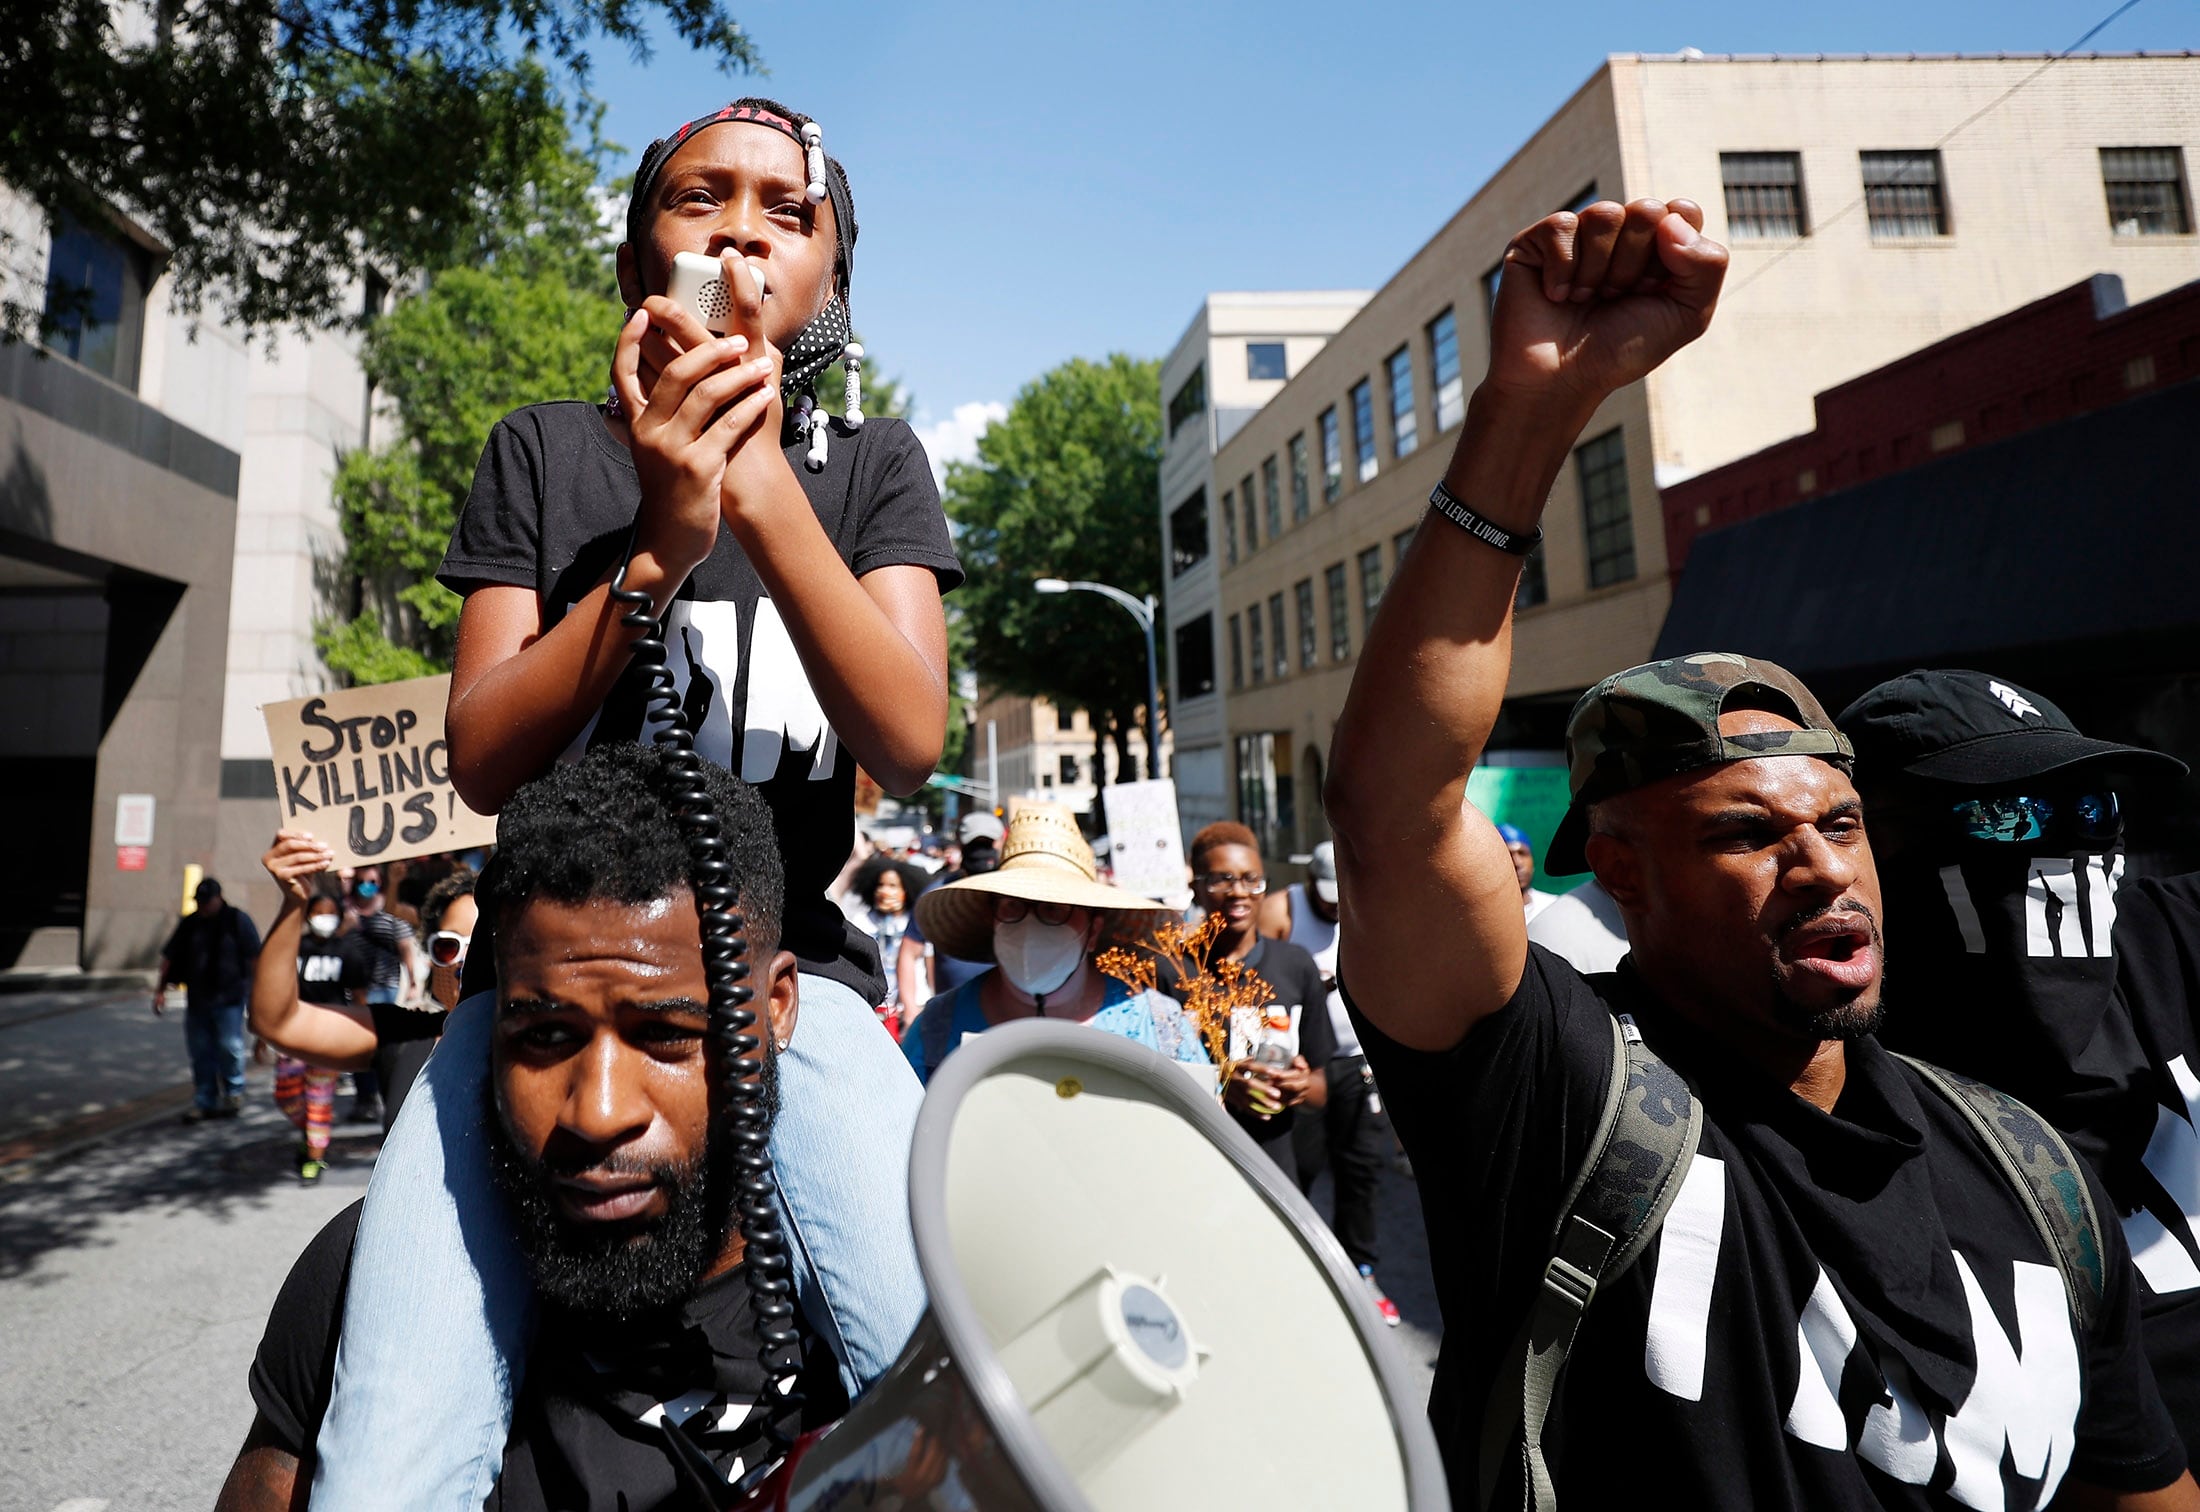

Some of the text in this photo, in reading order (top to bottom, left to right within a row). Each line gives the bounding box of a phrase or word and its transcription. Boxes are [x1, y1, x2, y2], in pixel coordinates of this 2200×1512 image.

[1445, 501, 1475, 530] LEVEL
[1473, 521, 1510, 549] LIVING.
[300, 698, 417, 763] STOP
[282, 739, 449, 817] KILLING
[348, 791, 457, 857] US!
